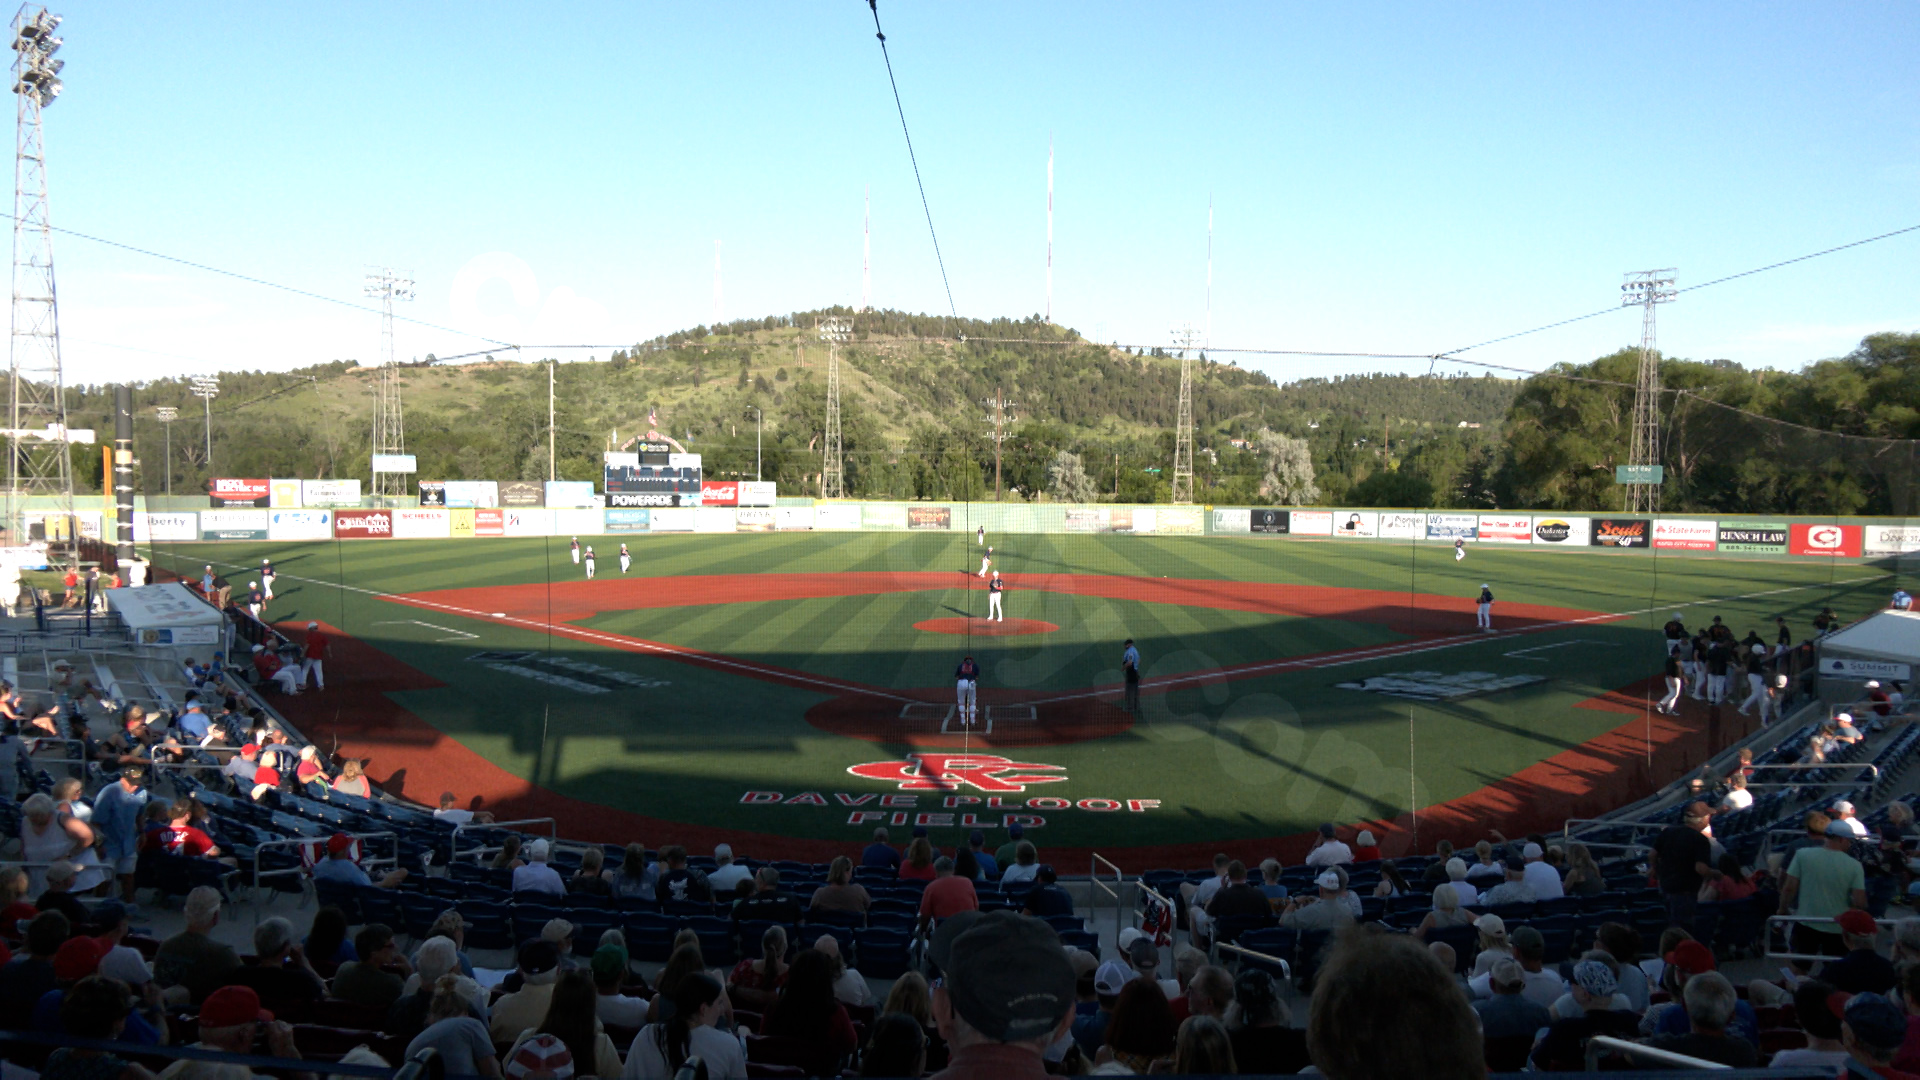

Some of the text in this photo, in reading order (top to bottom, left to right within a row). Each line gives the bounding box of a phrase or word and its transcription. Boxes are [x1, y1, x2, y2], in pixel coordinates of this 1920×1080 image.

[611, 495, 673, 506] POWERADE
[1667, 525, 1688, 535] State
[1719, 530, 1786, 542] RENSCH LAW
[1849, 662, 1899, 672] SUMMIT
[738, 791, 1162, 812] DAVE PLOOF
[847, 810, 1048, 829] FIELD
